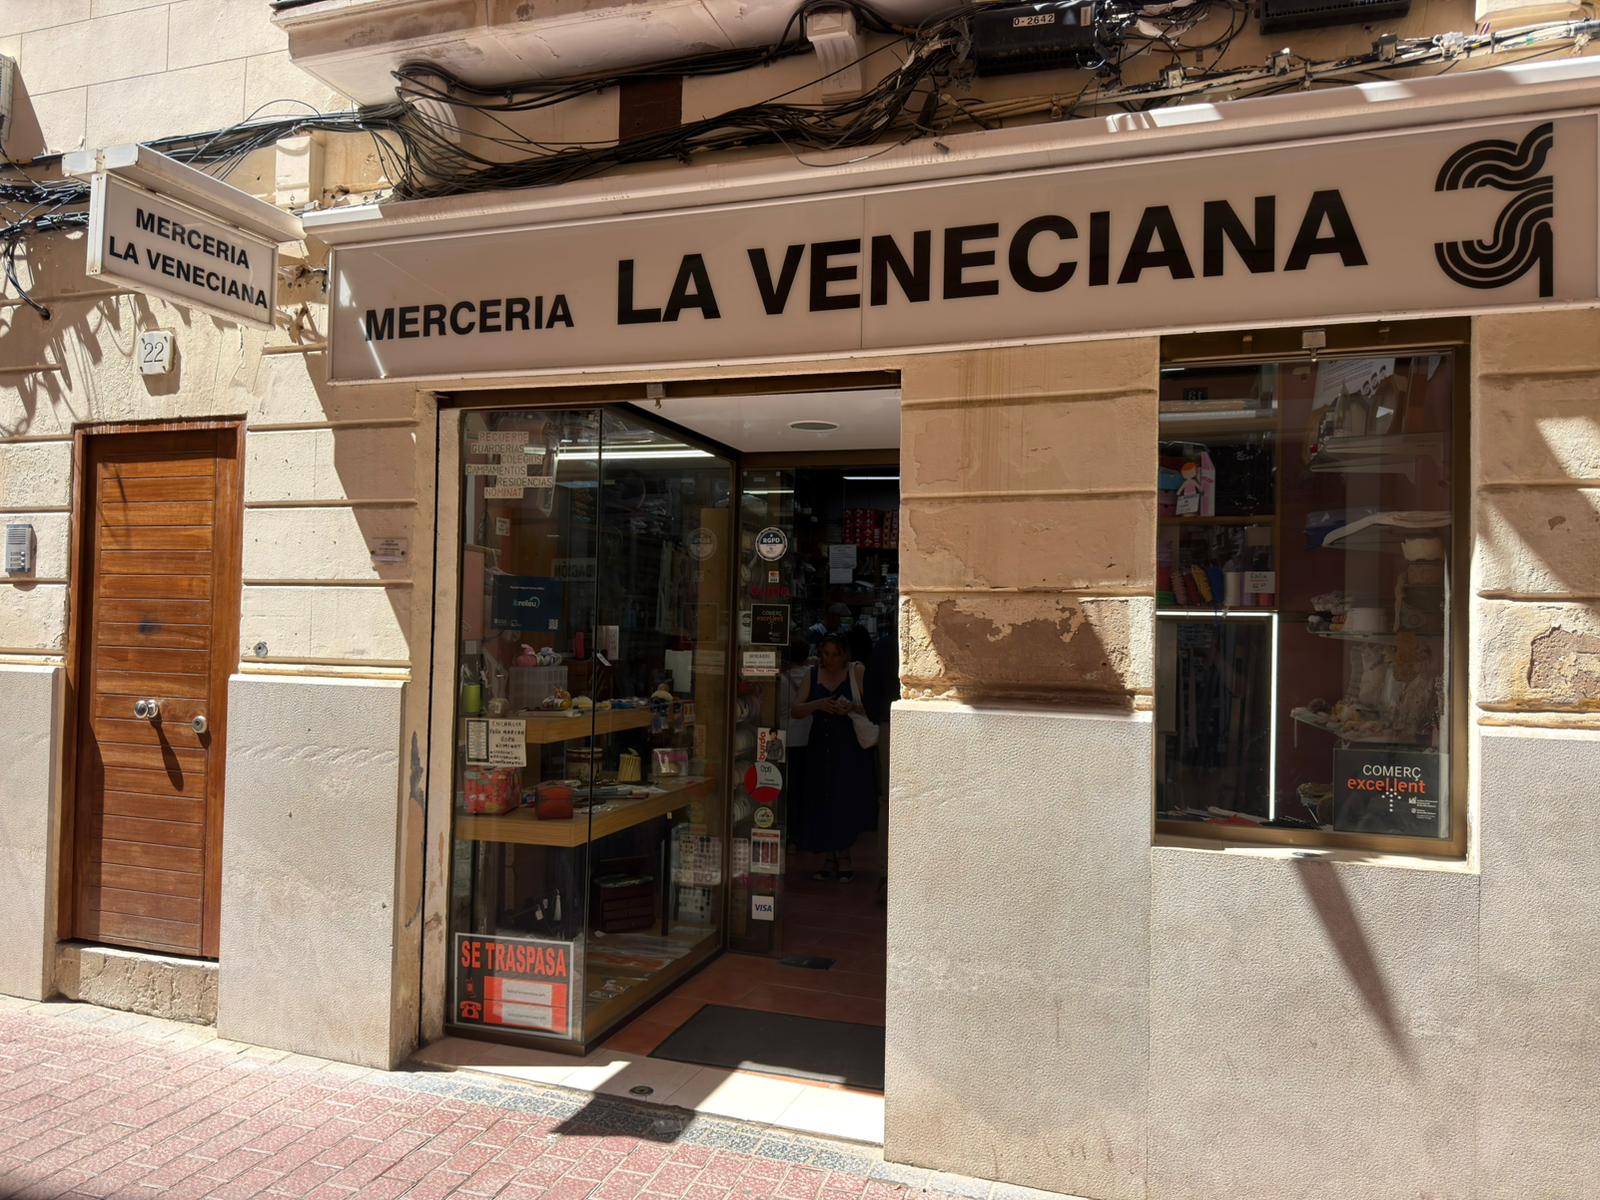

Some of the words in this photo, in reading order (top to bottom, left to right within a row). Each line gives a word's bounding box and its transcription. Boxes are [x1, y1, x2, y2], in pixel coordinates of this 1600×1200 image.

[136, 207, 250, 269] MERCERIA
[109, 236, 139, 265] LA
[147, 248, 268, 309] VENECIANA
[365, 294, 574, 341] MERCERIA
[617, 253, 721, 325] LA
[747, 188, 1368, 315] VENECIANA
[143, 341, 164, 363] 22
[501, 455, 543, 464] COLEGIOS
[497, 477, 552, 487] RESIDENCIAS
[758, 731, 767, 761] burda
[1362, 764, 1421, 781] COMERÇ
[755, 904, 773, 913] VISA
[461, 940, 482, 969] SE
[485, 943, 567, 977] TRASPASA
